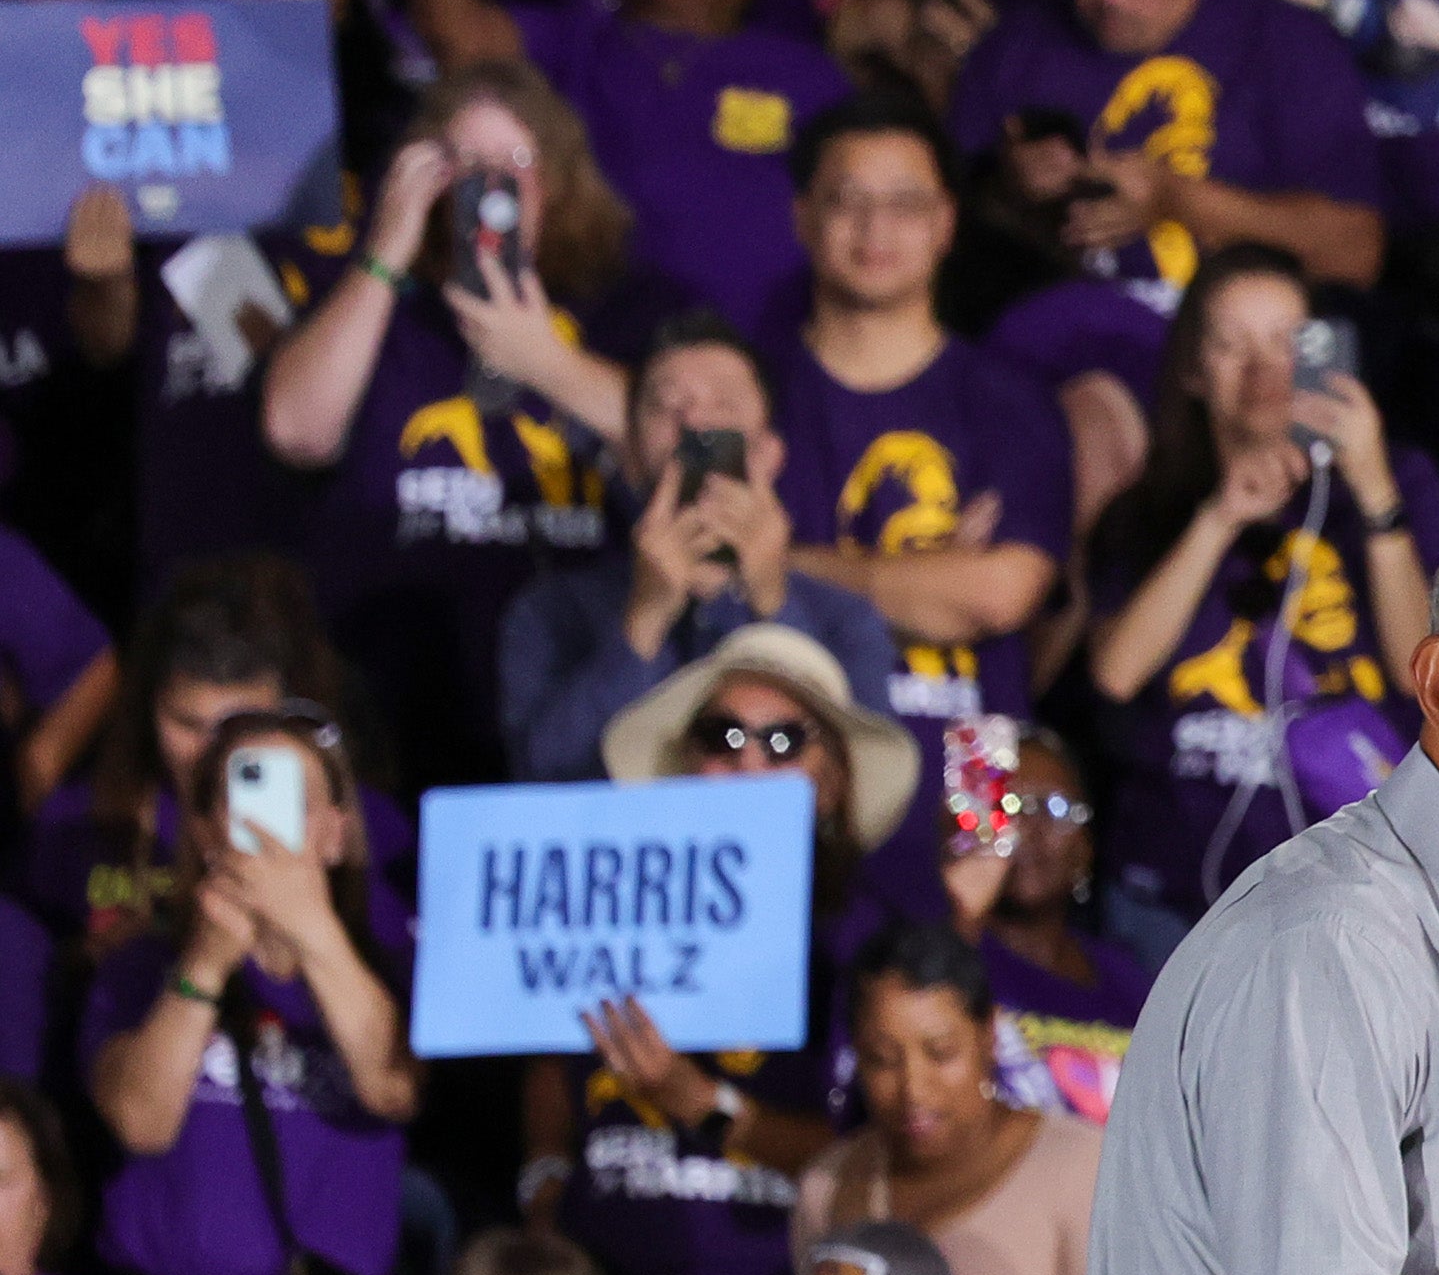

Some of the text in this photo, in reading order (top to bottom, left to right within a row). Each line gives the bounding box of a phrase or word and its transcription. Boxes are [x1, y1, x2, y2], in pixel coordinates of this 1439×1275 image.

[80, 12, 217, 66] YES
[82, 63, 223, 126] SHE
[82, 123, 232, 180] CAN
[482, 839, 748, 932] HARRIS
[515, 941, 703, 995] WALZ
